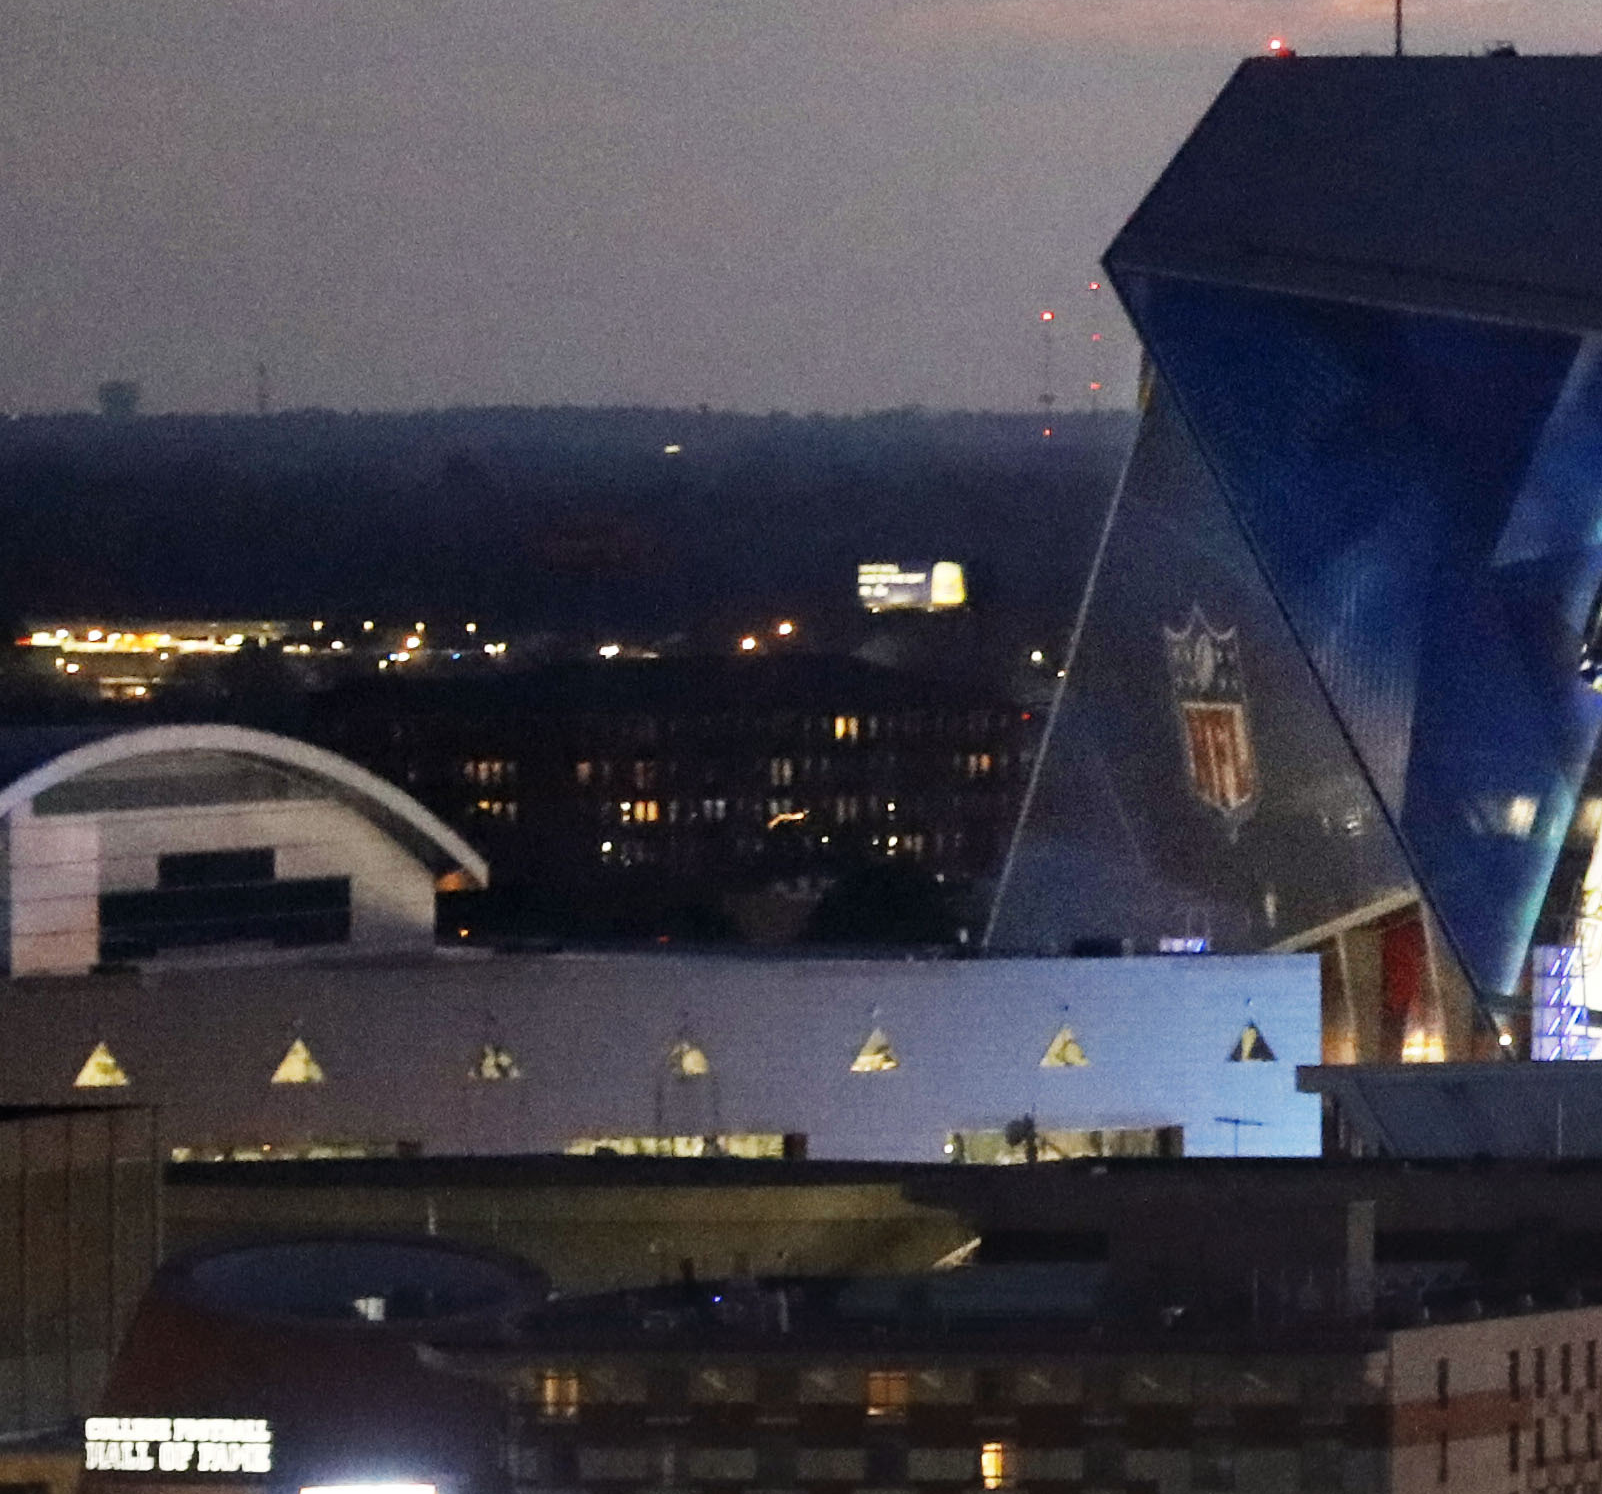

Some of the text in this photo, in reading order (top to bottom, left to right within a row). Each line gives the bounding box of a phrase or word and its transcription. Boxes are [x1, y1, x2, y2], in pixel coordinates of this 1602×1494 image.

[85, 1441, 272, 1473] HALL OF FAME
